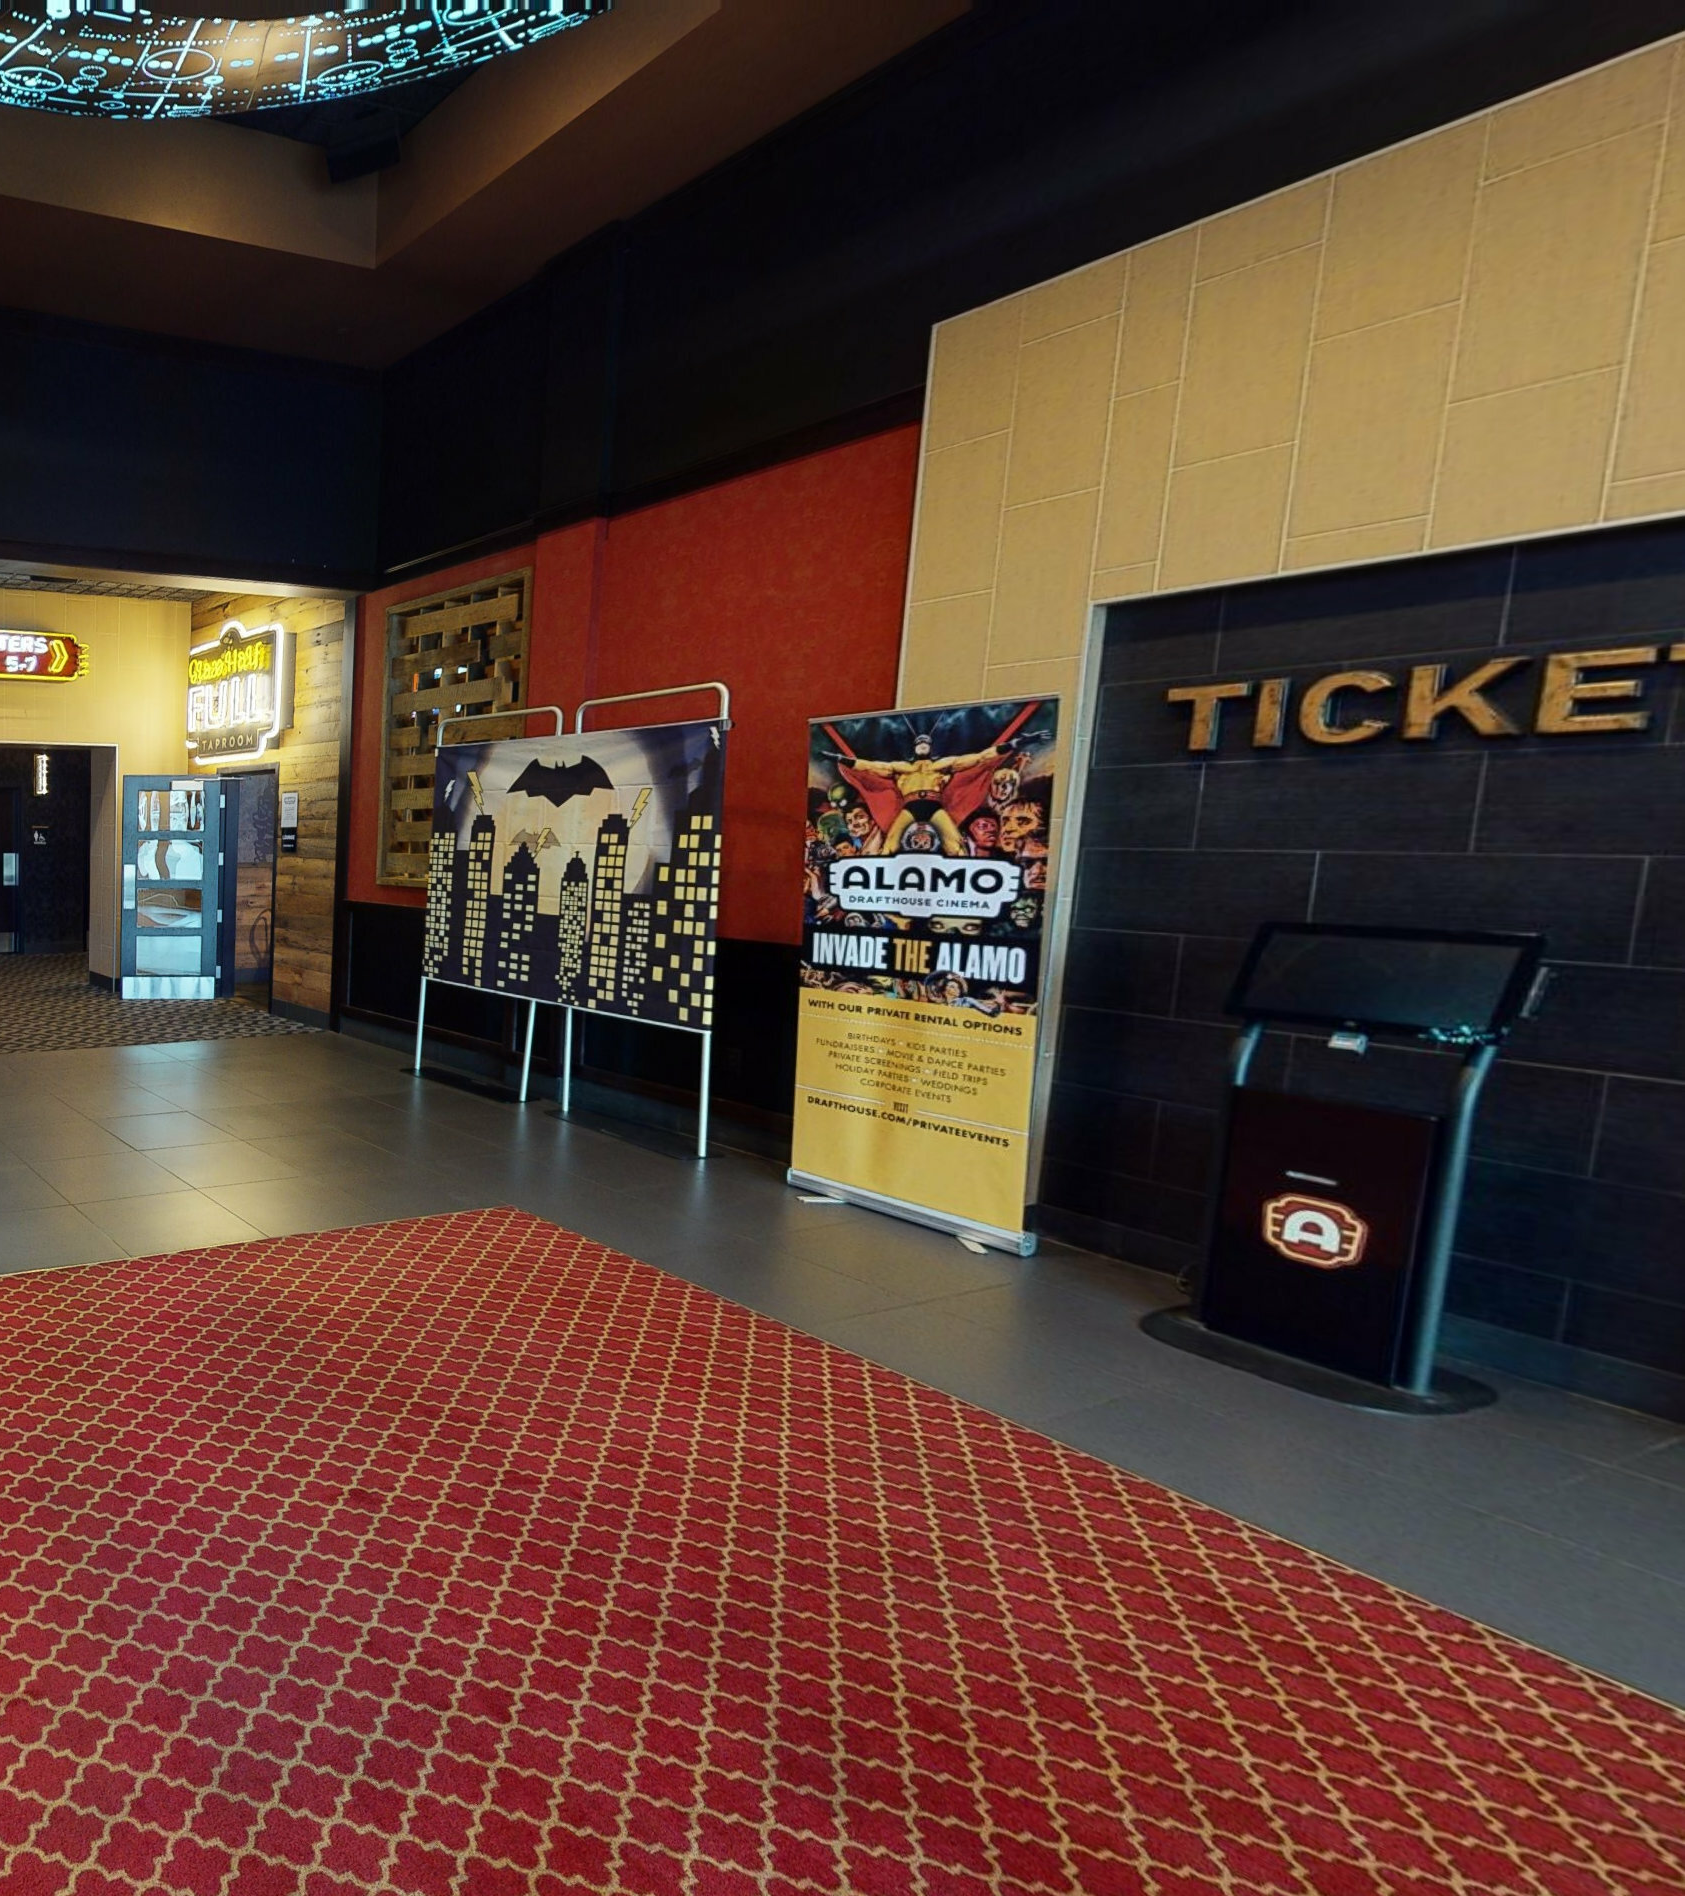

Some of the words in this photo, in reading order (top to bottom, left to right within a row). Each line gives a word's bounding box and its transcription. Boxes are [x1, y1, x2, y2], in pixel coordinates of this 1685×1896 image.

[5, 655, 37, 672] 5-7
[189, 658, 226, 684] Glass
[224, 641, 262, 672] Half
[188, 673, 264, 732] FULL
[1167, 644, 1685, 751] TICKE
[202, 735, 254, 750] TAPROOM
[841, 865, 1004, 894] ALAMO
[849, 895, 932, 907] DRAFTHOUSE
[936, 898, 990, 909] CINEMA
[812, 932, 889, 970] INVADE
[893, 938, 932, 974] THE
[936, 941, 1027, 984] ALAMO
[808, 998, 834, 1010] WITH
[838, 1003, 863, 1014] OUR
[867, 1007, 910, 1021] PRIVATE
[914, 1013, 958, 1027] RENTAL
[962, 1019, 1023, 1036] OPTIONS
[816, 1038, 875, 1054] FUNDRAISERS
[887, 1049, 914, 1062] MOVIE
[917, 1054, 924, 1063] &
[927, 1056, 963, 1070] DANCE
[967, 1062, 1006, 1077] PARTIES
[847, 1032, 896, 1046] BIRTHDAYS
[907, 1041, 927, 1052] KIDS
[930, 1045, 968, 1058] PARTIES
[828, 1050, 861, 1063] PRIVATE
[864, 1056, 921, 1074] SCREENINGS
[933, 1068, 959, 1081] FIELD
[963, 1073, 988, 1086] TRIPS
[835, 1062, 875, 1075] HOLIDAY
[878, 1069, 909, 1083] PARTIES
[920, 1078, 978, 1096] WEDDINGS
[860, 1078, 912, 1096] CORPORATE
[915, 1088, 952, 1103] EVENTS
[807, 1095, 1010, 1148] DRAFTHOUSE.COM/PRIVATEEVENTS
